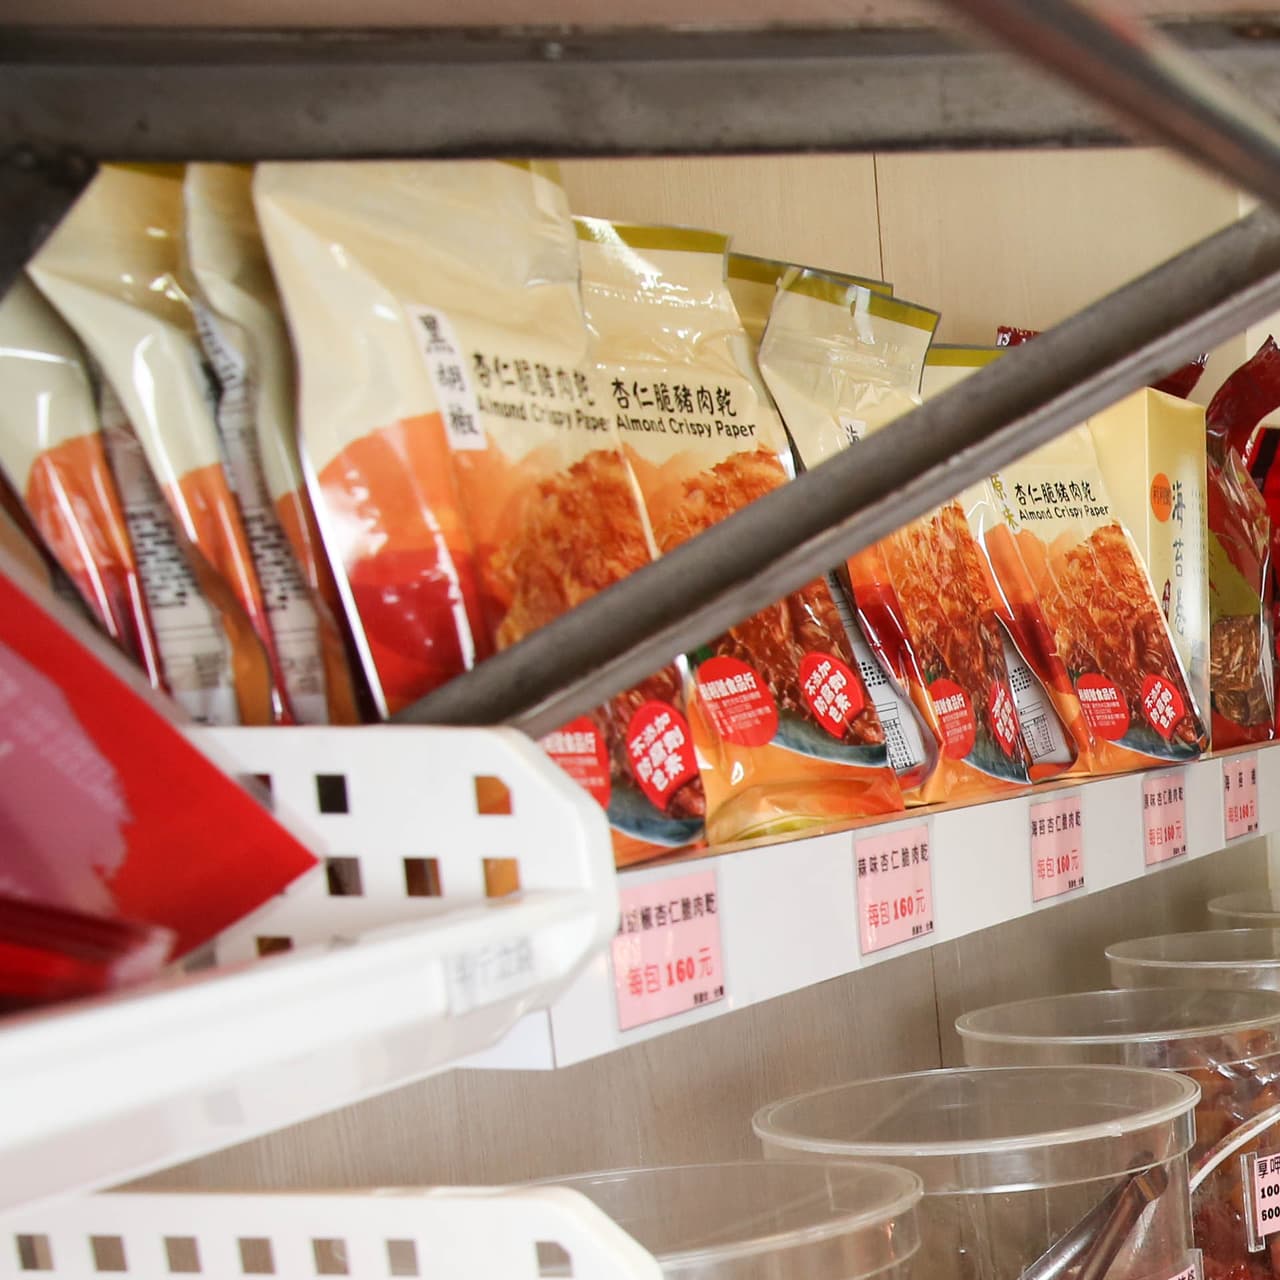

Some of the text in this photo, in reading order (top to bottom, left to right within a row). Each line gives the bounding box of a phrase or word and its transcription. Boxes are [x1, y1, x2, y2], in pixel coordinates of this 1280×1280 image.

[418, 314, 478, 436] 黑胡椒
[473, 351, 596, 406] 杏仁脆豬肉乾
[611, 377, 737, 417] 杏仁脆豬肉乾
[576, 409, 609, 432] Pape
[616, 414, 756, 438] Almond Crispy Paper
[1014, 480, 1096, 505] 杏仁脆豬肉乾
[1019, 504, 1109, 522] Almond Crispy Paper
[804, 660, 833, 696] 不添加
[814, 670, 848, 717] 防腐劑
[827, 693, 853, 724] 色素
